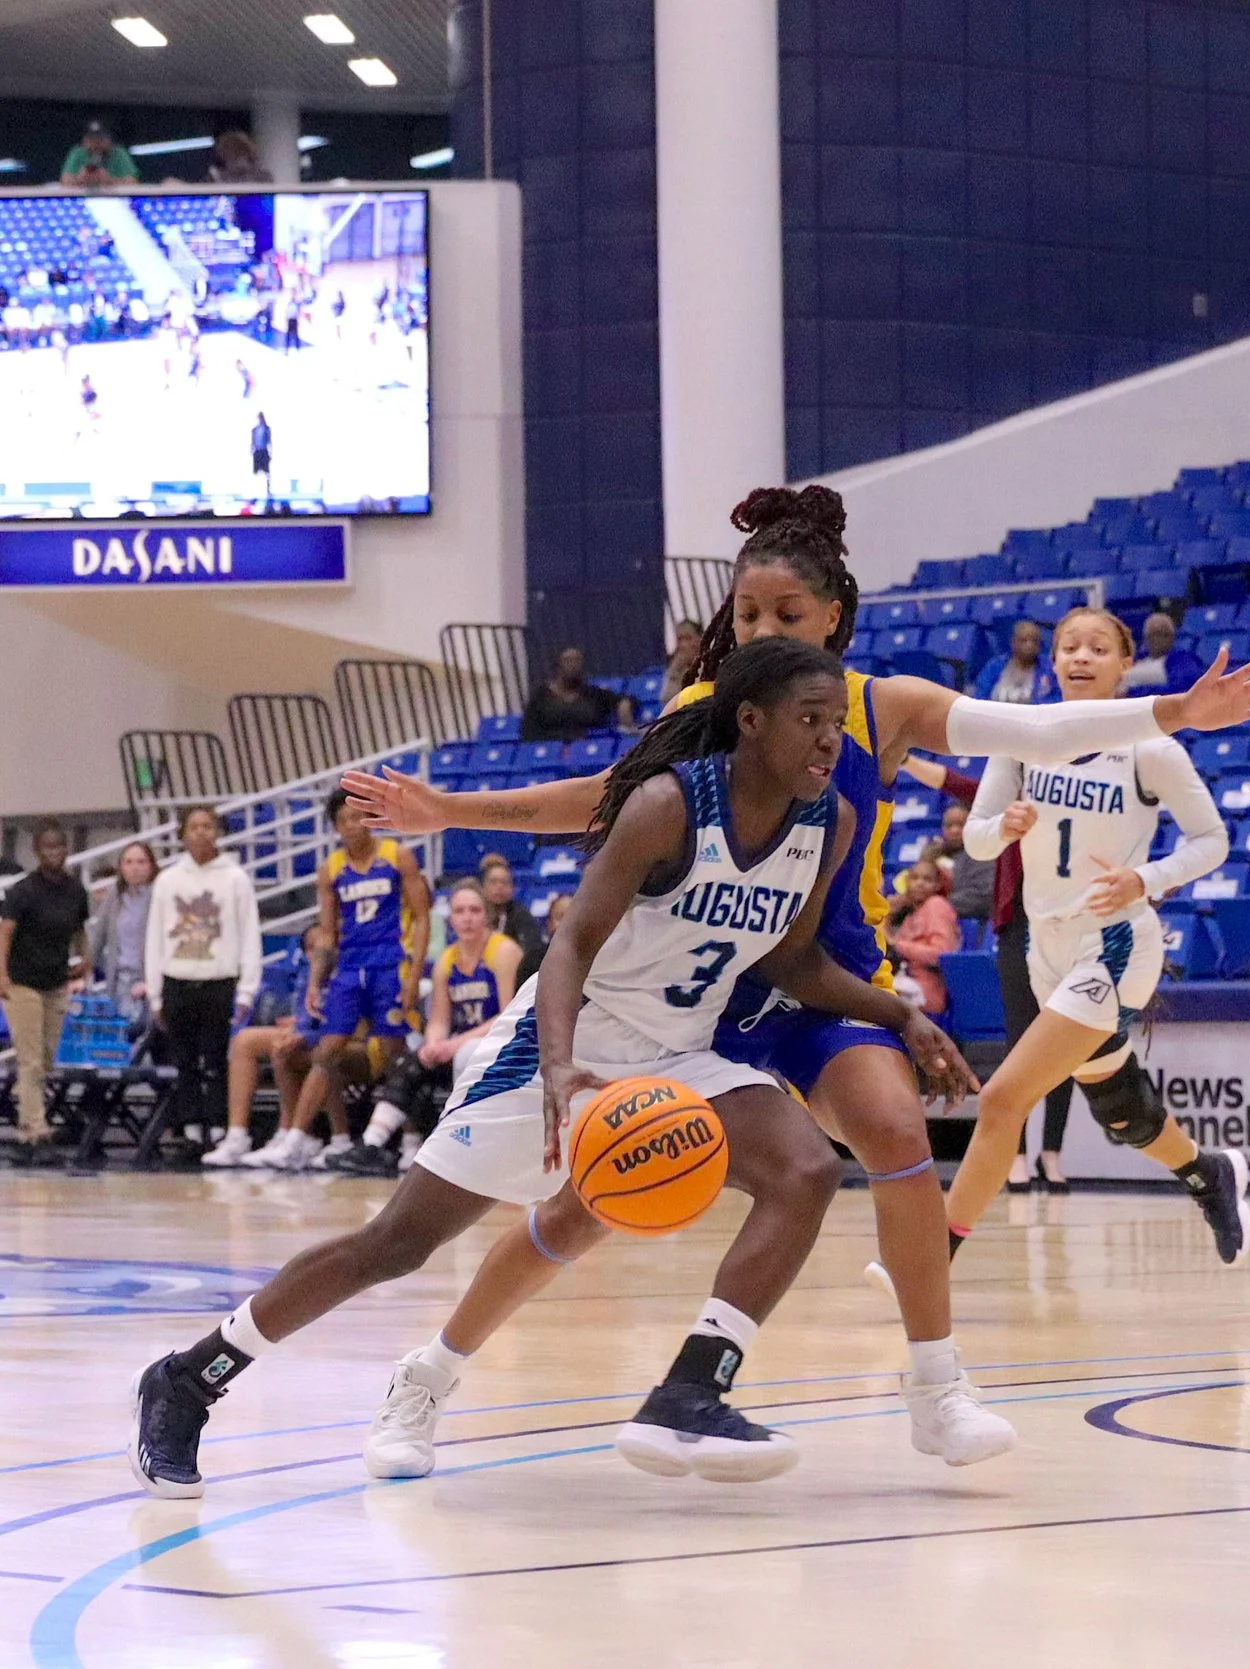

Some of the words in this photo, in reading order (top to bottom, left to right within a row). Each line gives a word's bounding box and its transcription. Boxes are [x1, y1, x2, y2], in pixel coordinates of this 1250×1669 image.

[73, 529, 232, 583] DASANI
[1057, 818, 1072, 877] 1
[671, 881, 803, 935] UGUSTA
[664, 939, 738, 1009] 3
[603, 1085, 677, 1130] NCAA
[611, 1116, 715, 1174] Wilson
